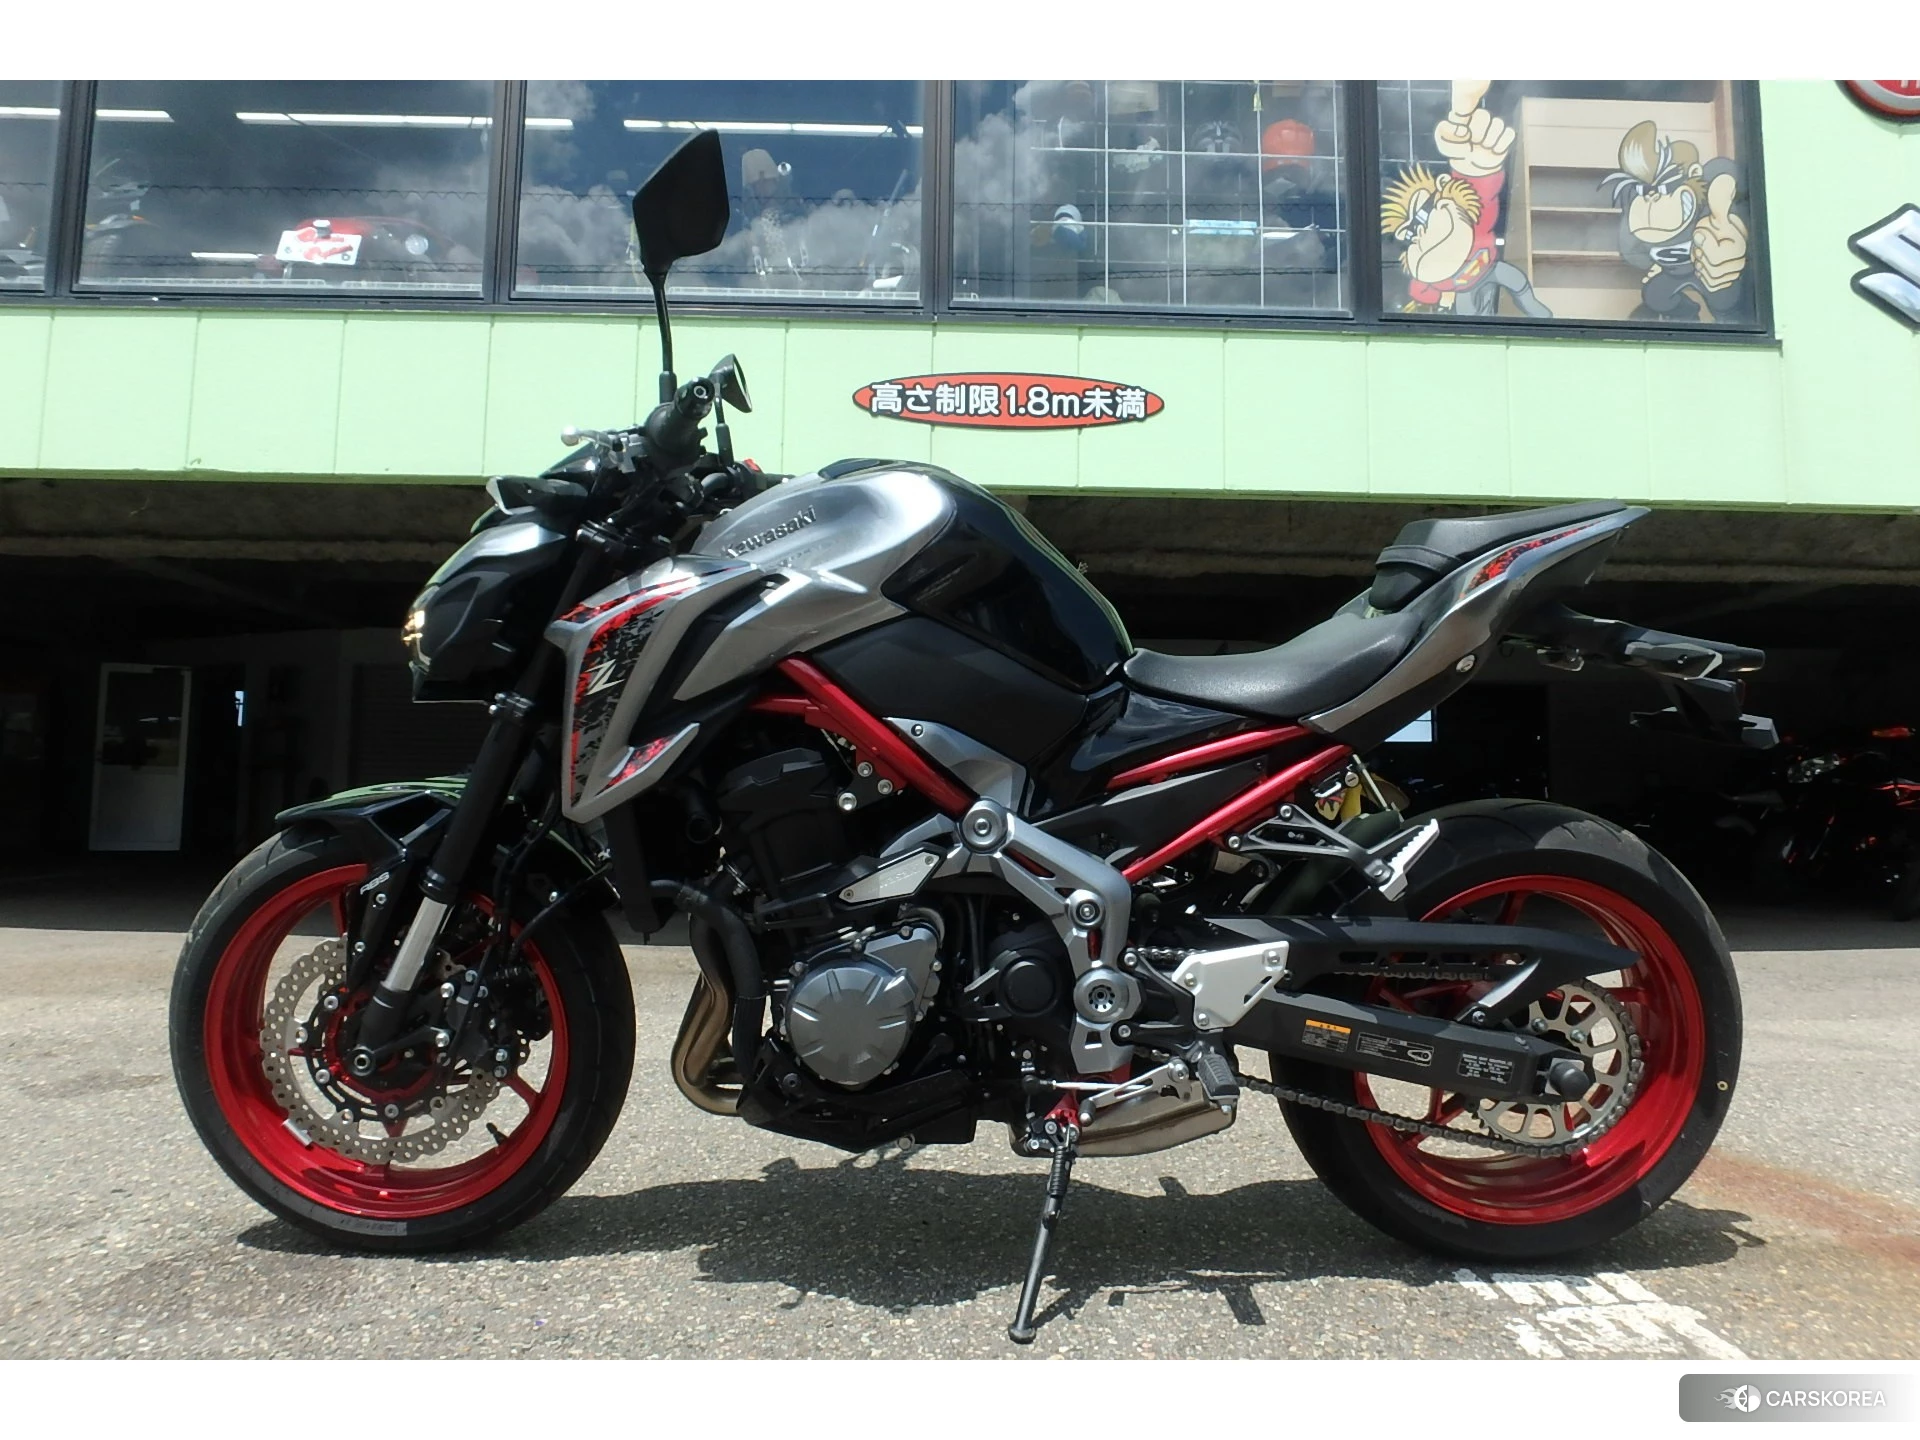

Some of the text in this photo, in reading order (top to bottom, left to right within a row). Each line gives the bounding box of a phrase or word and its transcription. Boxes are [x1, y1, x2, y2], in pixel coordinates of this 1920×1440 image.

[871, 383, 1147, 418] 高さ制限1.8m未満
[721, 504, 816, 558] Kawasaki
[360, 871, 389, 895] ABS
